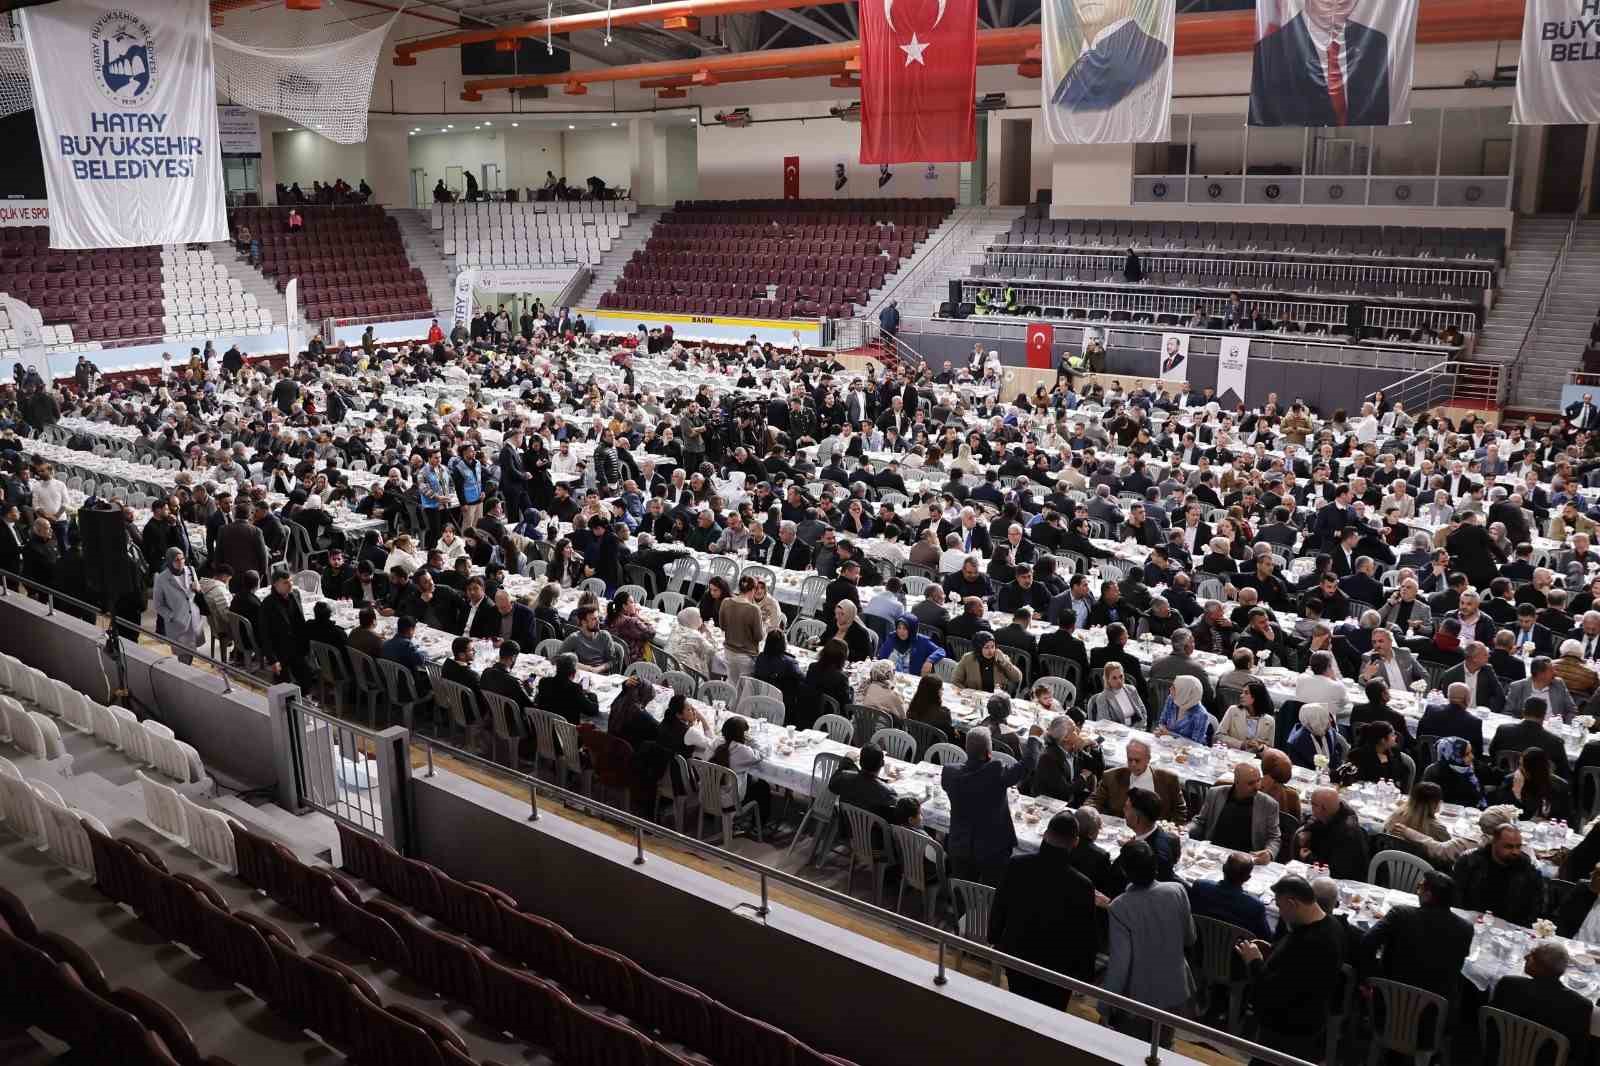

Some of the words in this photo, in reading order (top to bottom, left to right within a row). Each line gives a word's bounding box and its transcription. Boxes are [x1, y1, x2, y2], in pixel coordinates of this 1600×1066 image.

[91, 112, 167, 133] HATAY
[60, 135, 203, 157] BÜYÜKŞEHİR
[73, 159, 194, 180] BELEDİYESİ
[19, 208, 31, 220] VE
